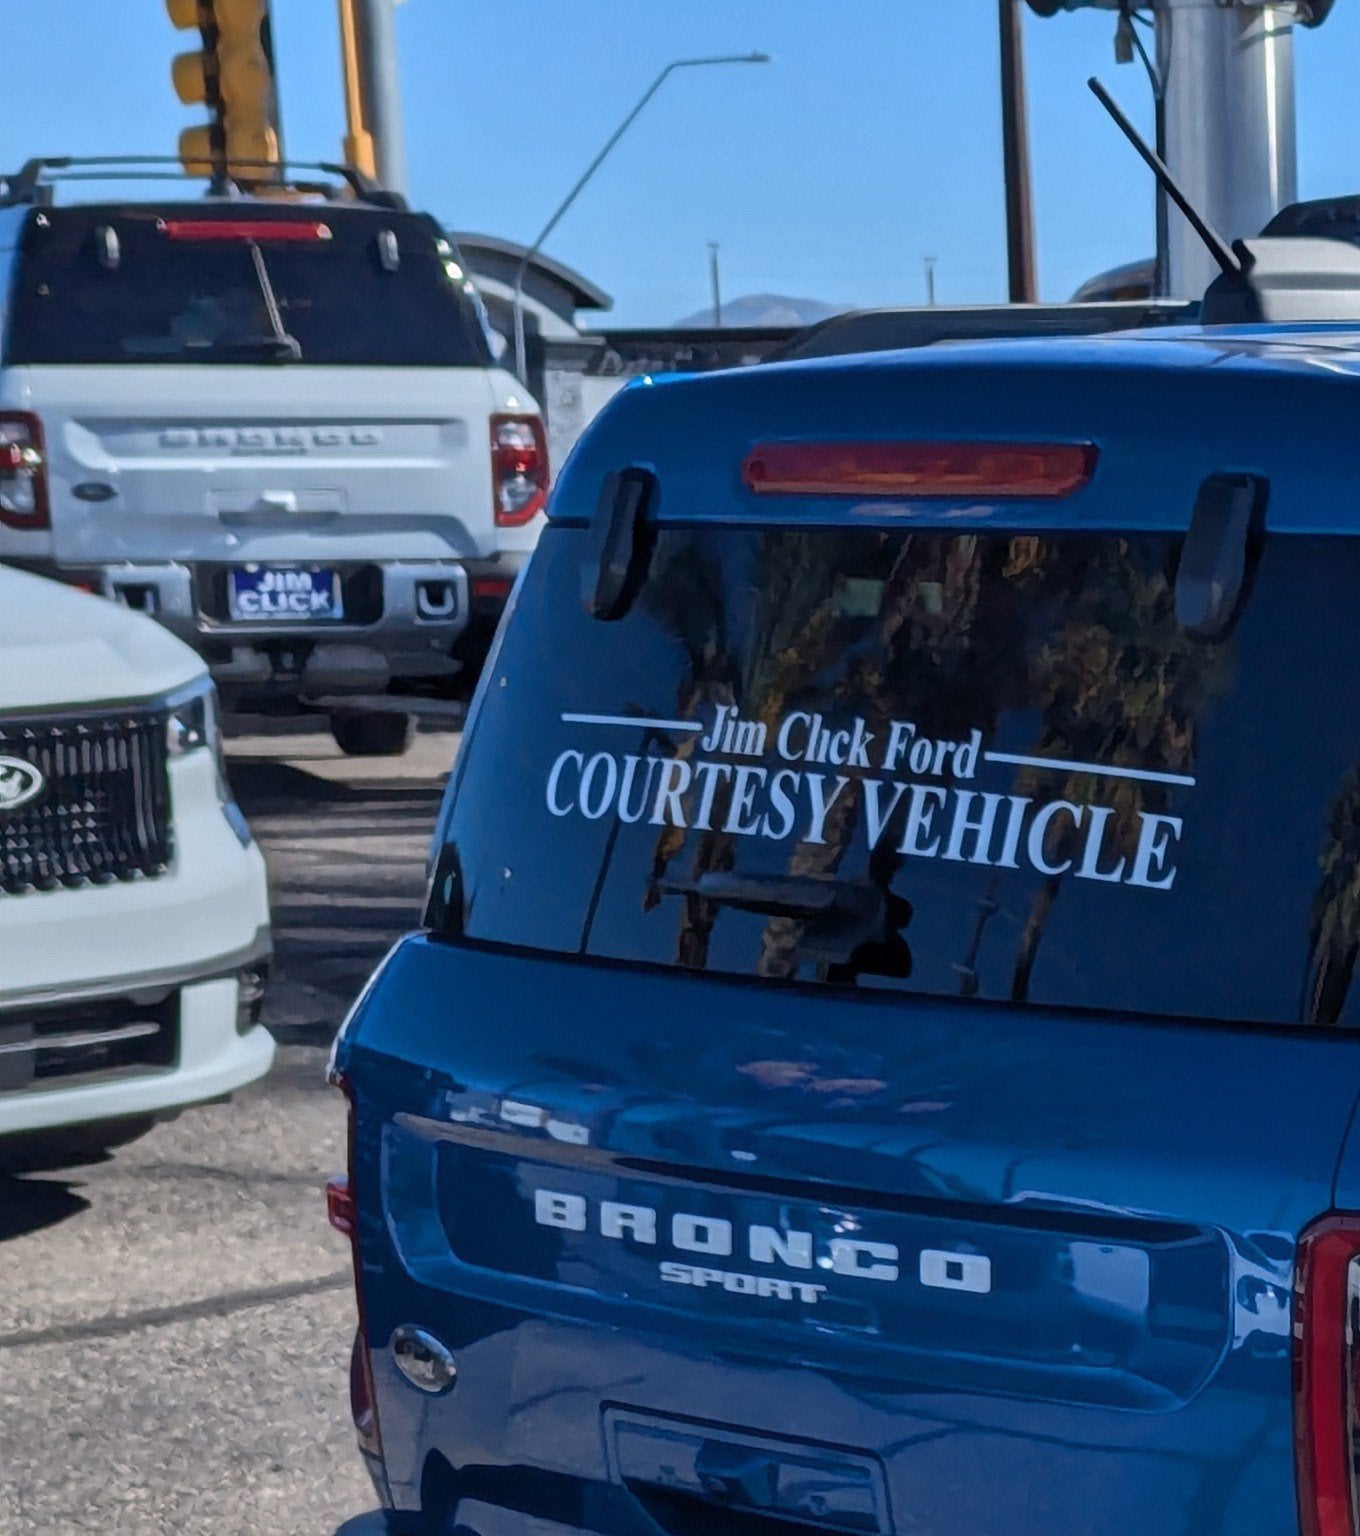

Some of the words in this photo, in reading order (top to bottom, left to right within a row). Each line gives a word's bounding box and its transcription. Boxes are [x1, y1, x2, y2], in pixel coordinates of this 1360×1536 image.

[238, 588, 331, 612] CLICK
[257, 571, 312, 592] JIM
[702, 704, 765, 757] Jim
[777, 711, 871, 767] Click
[881, 721, 984, 779] Ford
[545, 748, 851, 845] COURTESY
[864, 777, 1184, 891] VEHICLE
[534, 1188, 992, 1294] BRONCO
[659, 1261, 828, 1304] SPORT
